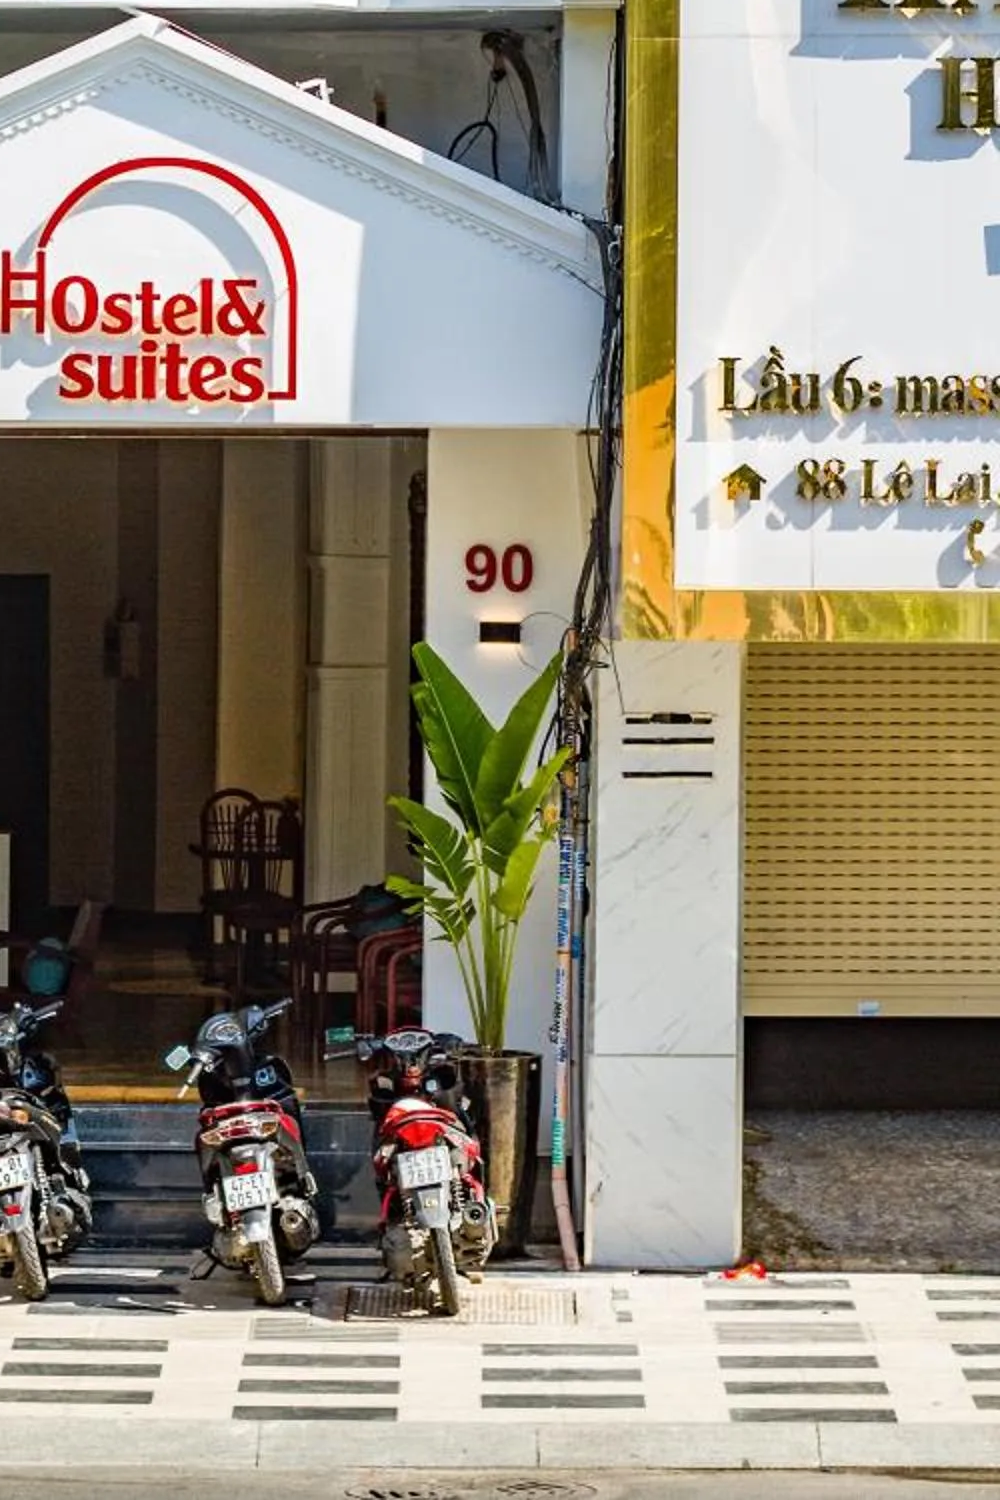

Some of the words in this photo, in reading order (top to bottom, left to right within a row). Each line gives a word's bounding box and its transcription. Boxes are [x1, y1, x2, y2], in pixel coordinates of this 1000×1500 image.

[59, 339, 266, 402] suites
[718, 345, 821, 414] Lầu
[795, 458, 847, 501] 88
[859, 458, 914, 502] Lê
[465, 543, 533, 593] 90
